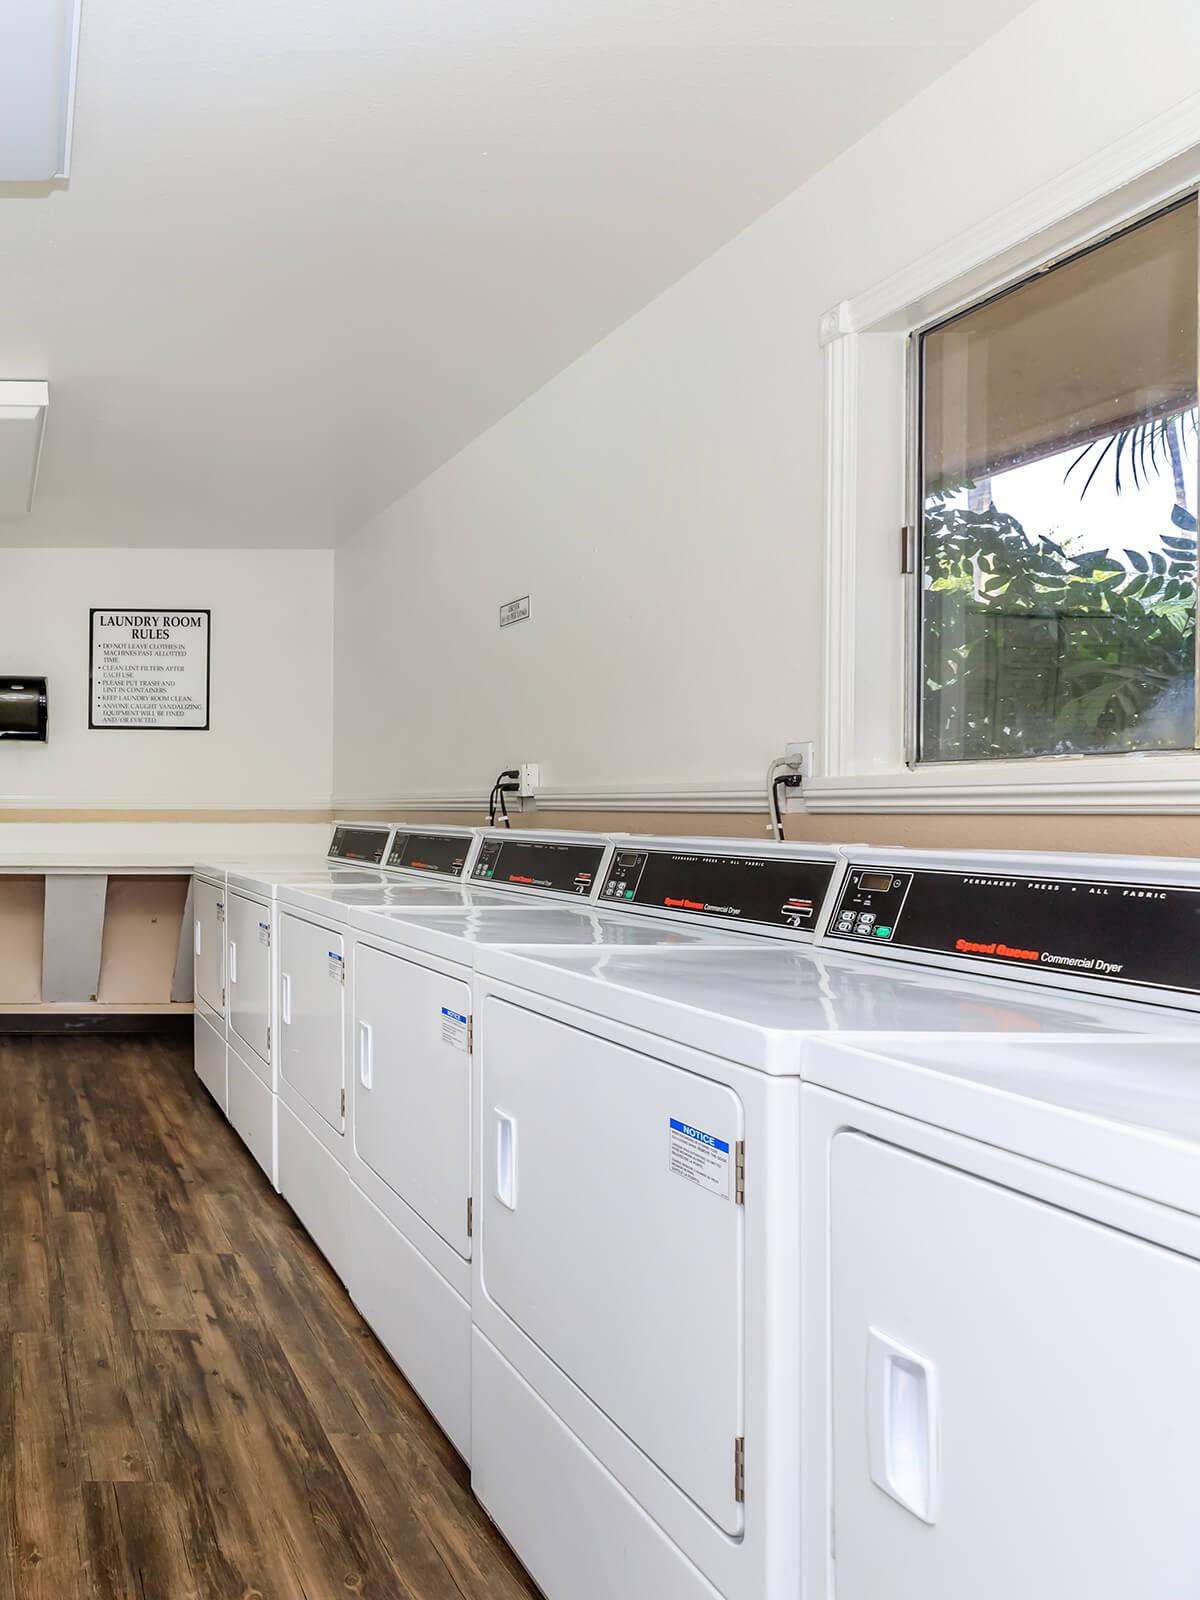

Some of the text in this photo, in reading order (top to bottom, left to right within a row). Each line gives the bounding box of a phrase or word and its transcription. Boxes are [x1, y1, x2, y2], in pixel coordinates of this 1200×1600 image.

[100, 616, 201, 627] LAUNDRY ROOM
[132, 629, 170, 640] RULES
[963, 878, 1167, 899] PERMANENT PRESS ALL FABRIC
[955, 938, 1123, 974] Speed Queen Commercial Dryer
[682, 1125, 716, 1146] NOTICE
